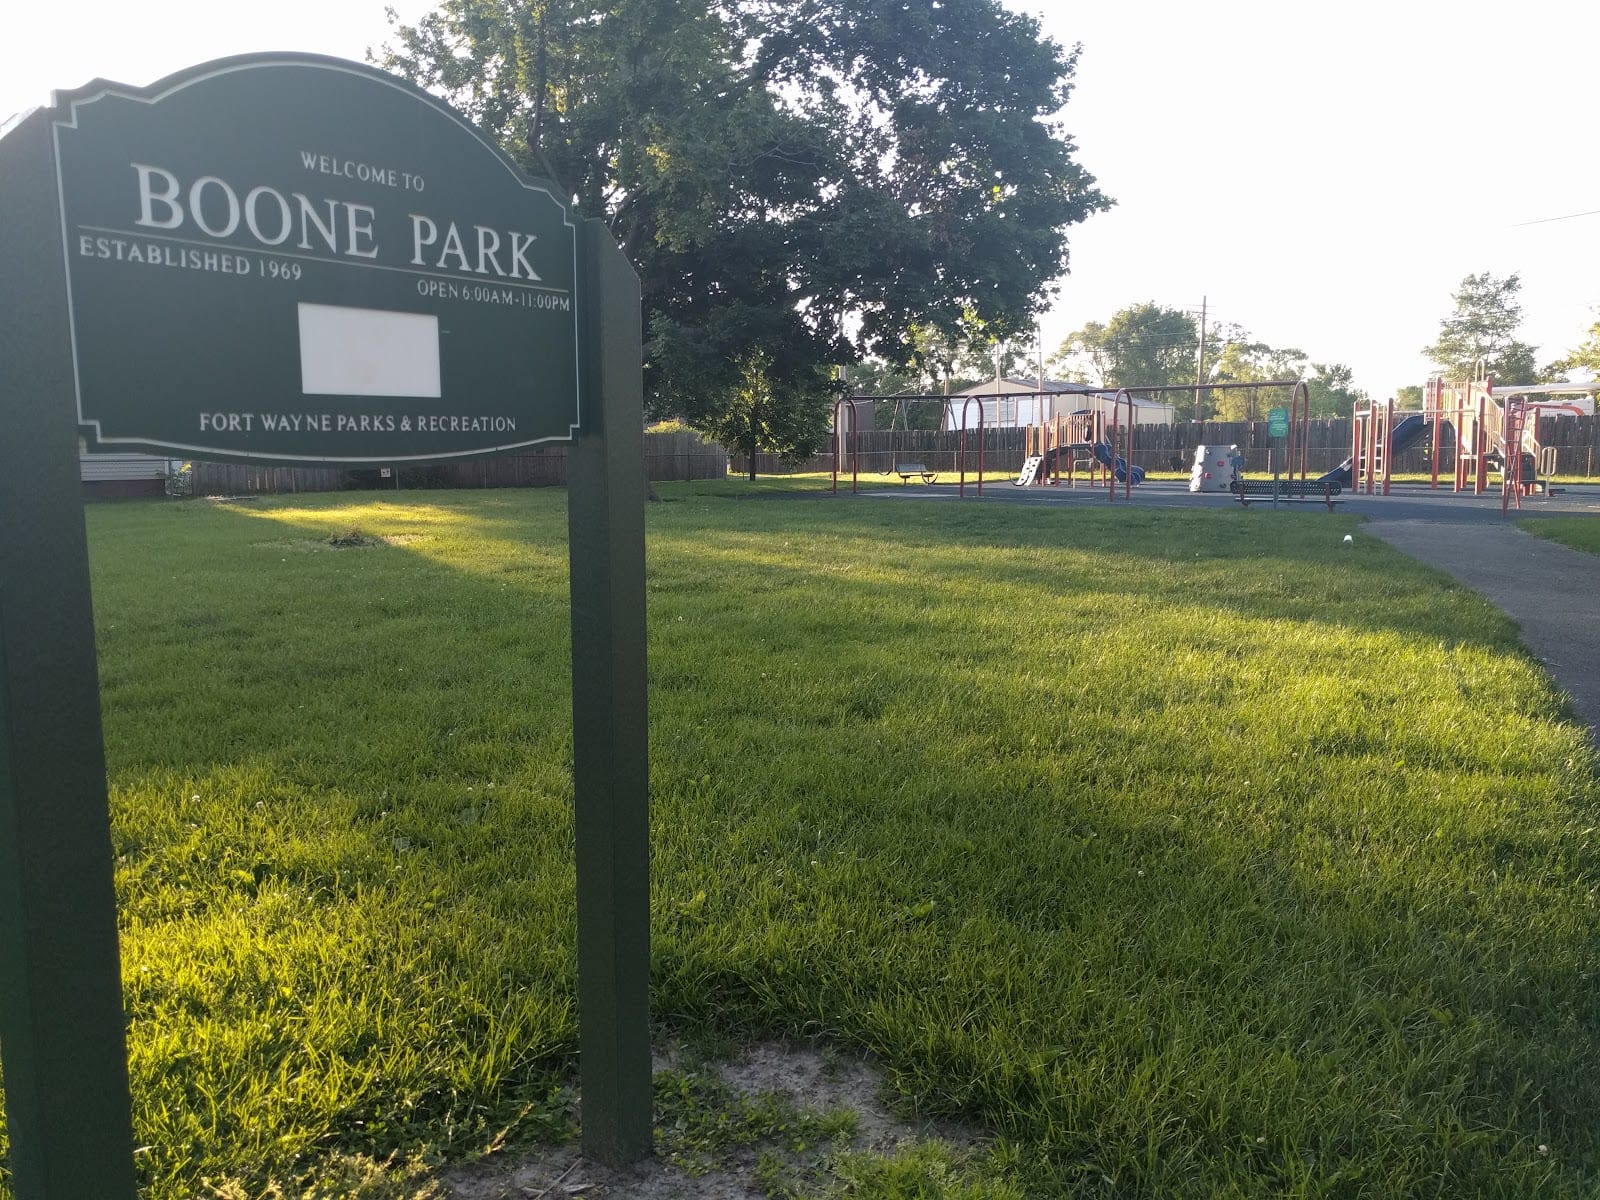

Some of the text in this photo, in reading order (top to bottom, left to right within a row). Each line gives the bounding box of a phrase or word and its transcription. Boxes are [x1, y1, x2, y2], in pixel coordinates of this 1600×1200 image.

[301, 151, 426, 193] WELCOME TO
[130, 162, 543, 282] BOONE PARK
[79, 235, 303, 282] ESTABLISHED 1969
[417, 279, 571, 312] OPEN 6:00AM-11:00PM
[199, 412, 517, 433] FORT WAYNE PARKS & RECREATION
